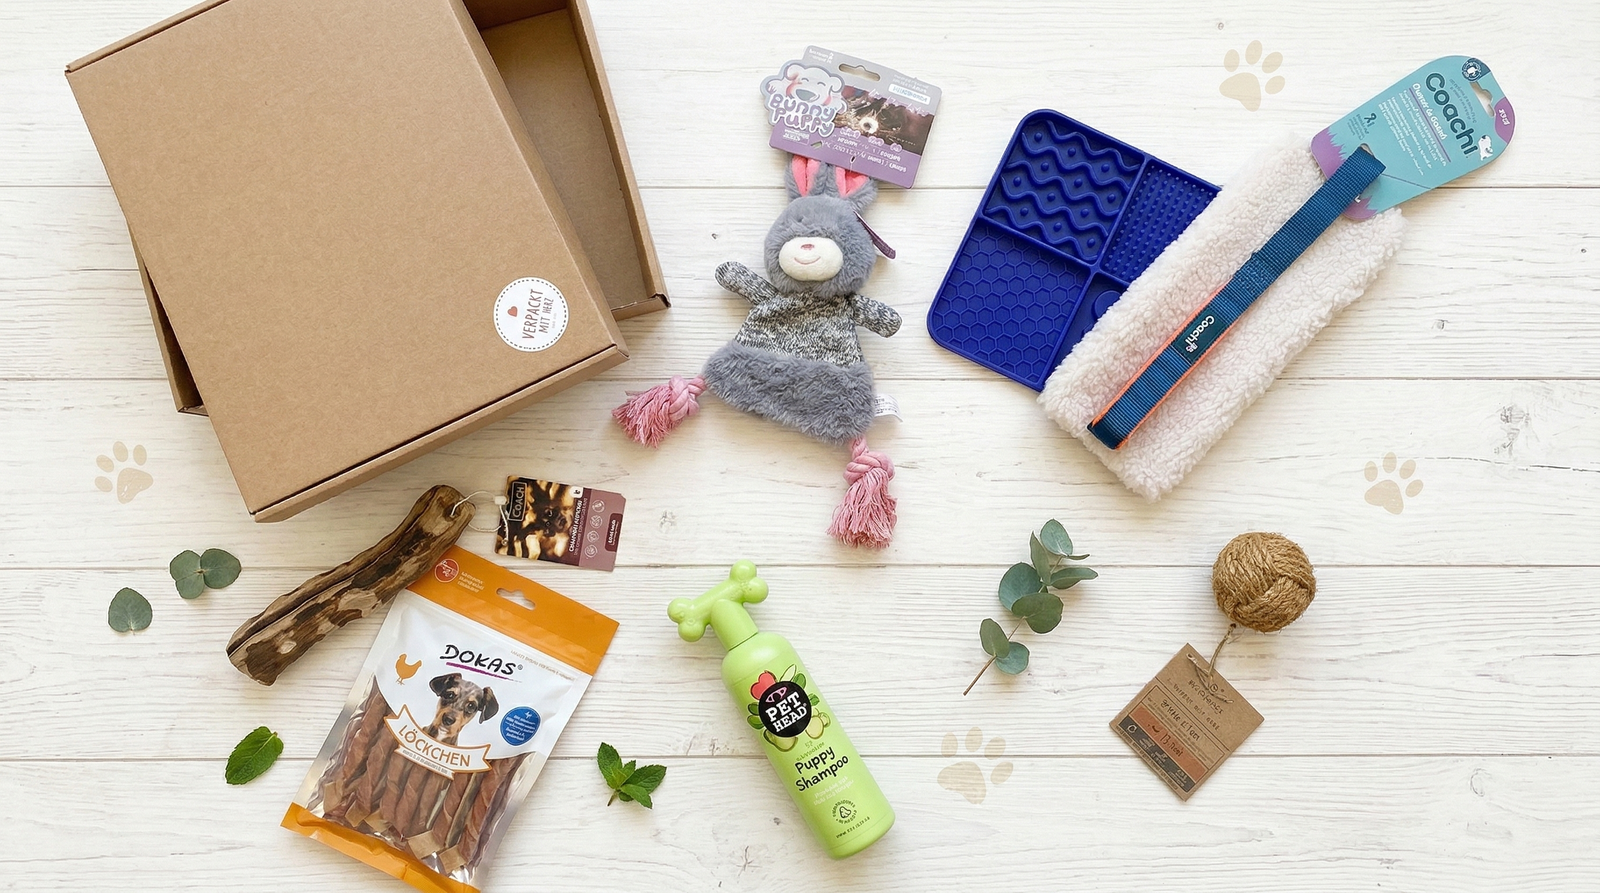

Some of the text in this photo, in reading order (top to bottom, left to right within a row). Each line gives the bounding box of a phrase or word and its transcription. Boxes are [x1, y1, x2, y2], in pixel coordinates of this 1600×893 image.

[1425, 72, 1478, 156] Coachi
[522, 288, 543, 339] VERPACKT
[542, 297, 554, 314] HERZ
[538, 316, 551, 333] MIT
[1185, 315, 1215, 346] Coachi
[512, 486, 525, 518] COACH
[765, 692, 800, 722] PET
[772, 706, 808, 733] HEAD
[398, 724, 471, 767] LÖCKCHEN
[794, 746, 836, 775] Puppy
[795, 755, 849, 791] Shampoo
